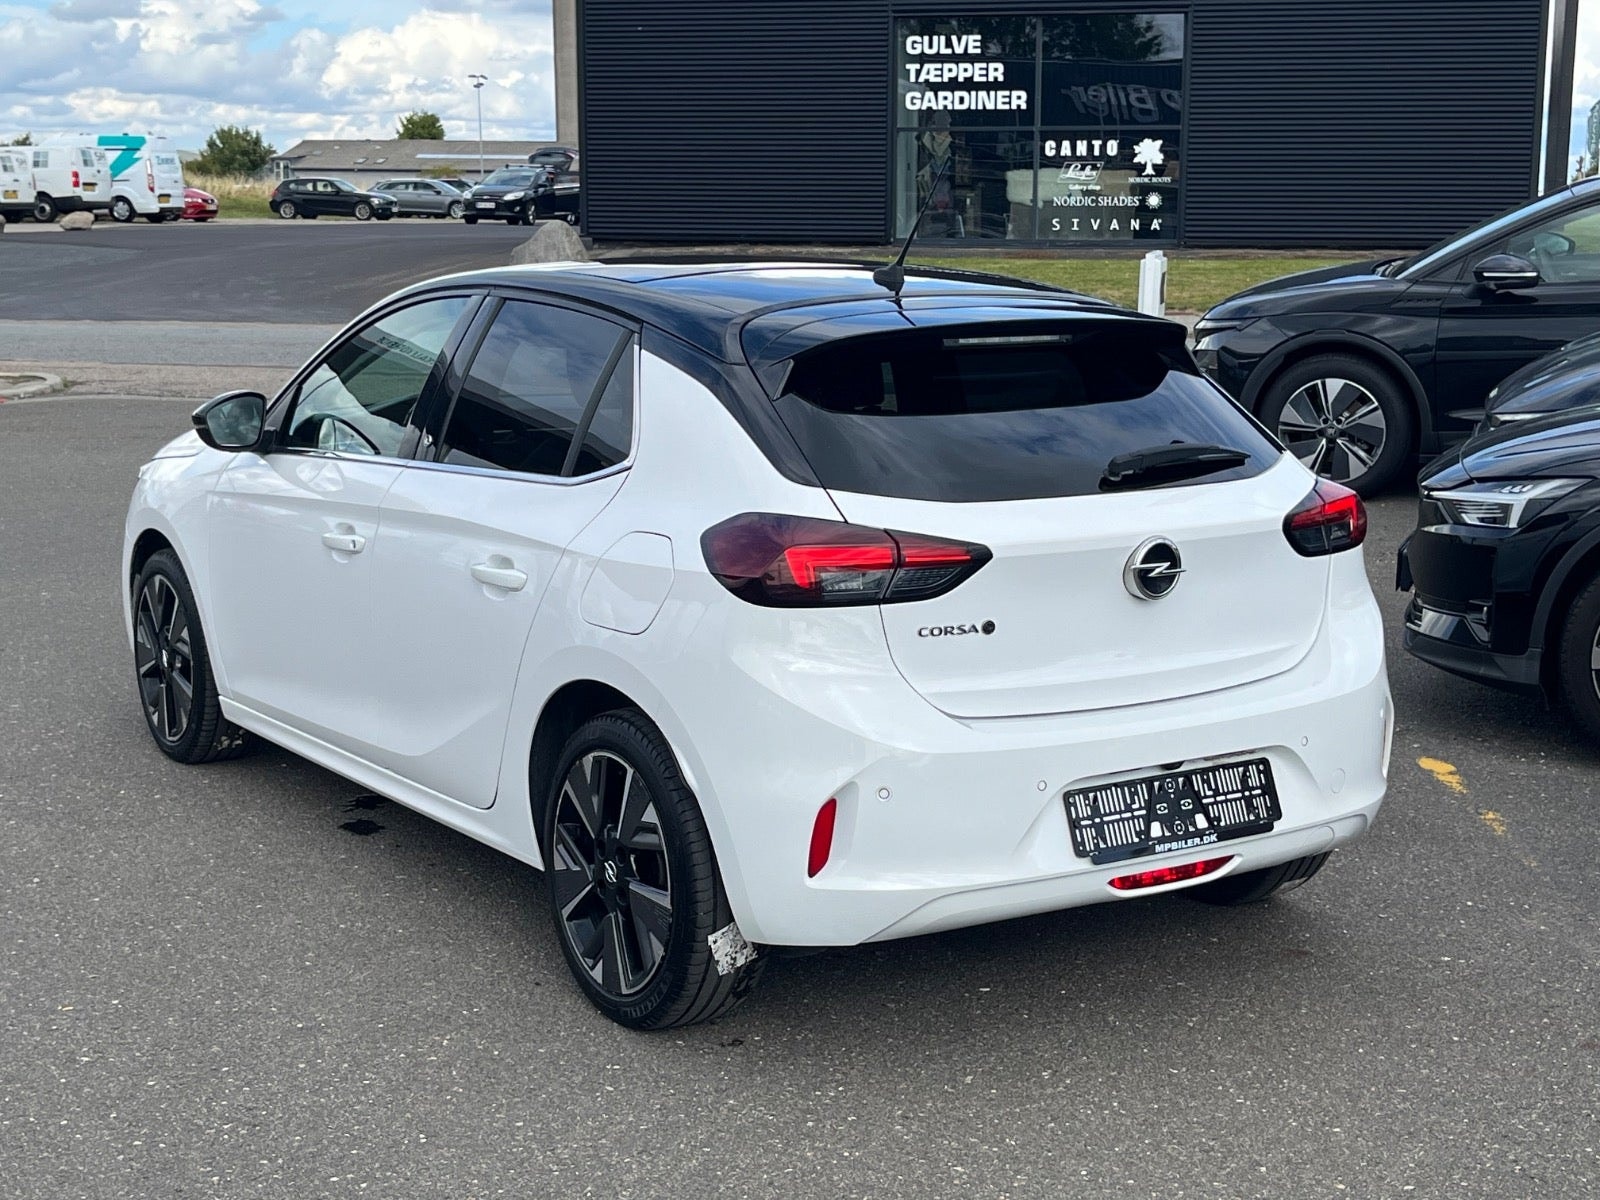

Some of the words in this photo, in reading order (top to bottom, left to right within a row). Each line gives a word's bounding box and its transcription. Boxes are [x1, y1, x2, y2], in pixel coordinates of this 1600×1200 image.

[905, 34, 982, 55] GULVE
[905, 62, 1005, 83] TÆPPER
[905, 90, 1028, 111] GARDINER
[1044, 139, 1118, 157] CANTO
[1053, 196, 1096, 207] NORDIC
[1097, 195, 1139, 207] SHADES
[1051, 218, 1162, 231] SIVANA
[918, 623, 979, 637] CORSA
[1155, 834, 1218, 852] MPBILER.DK
